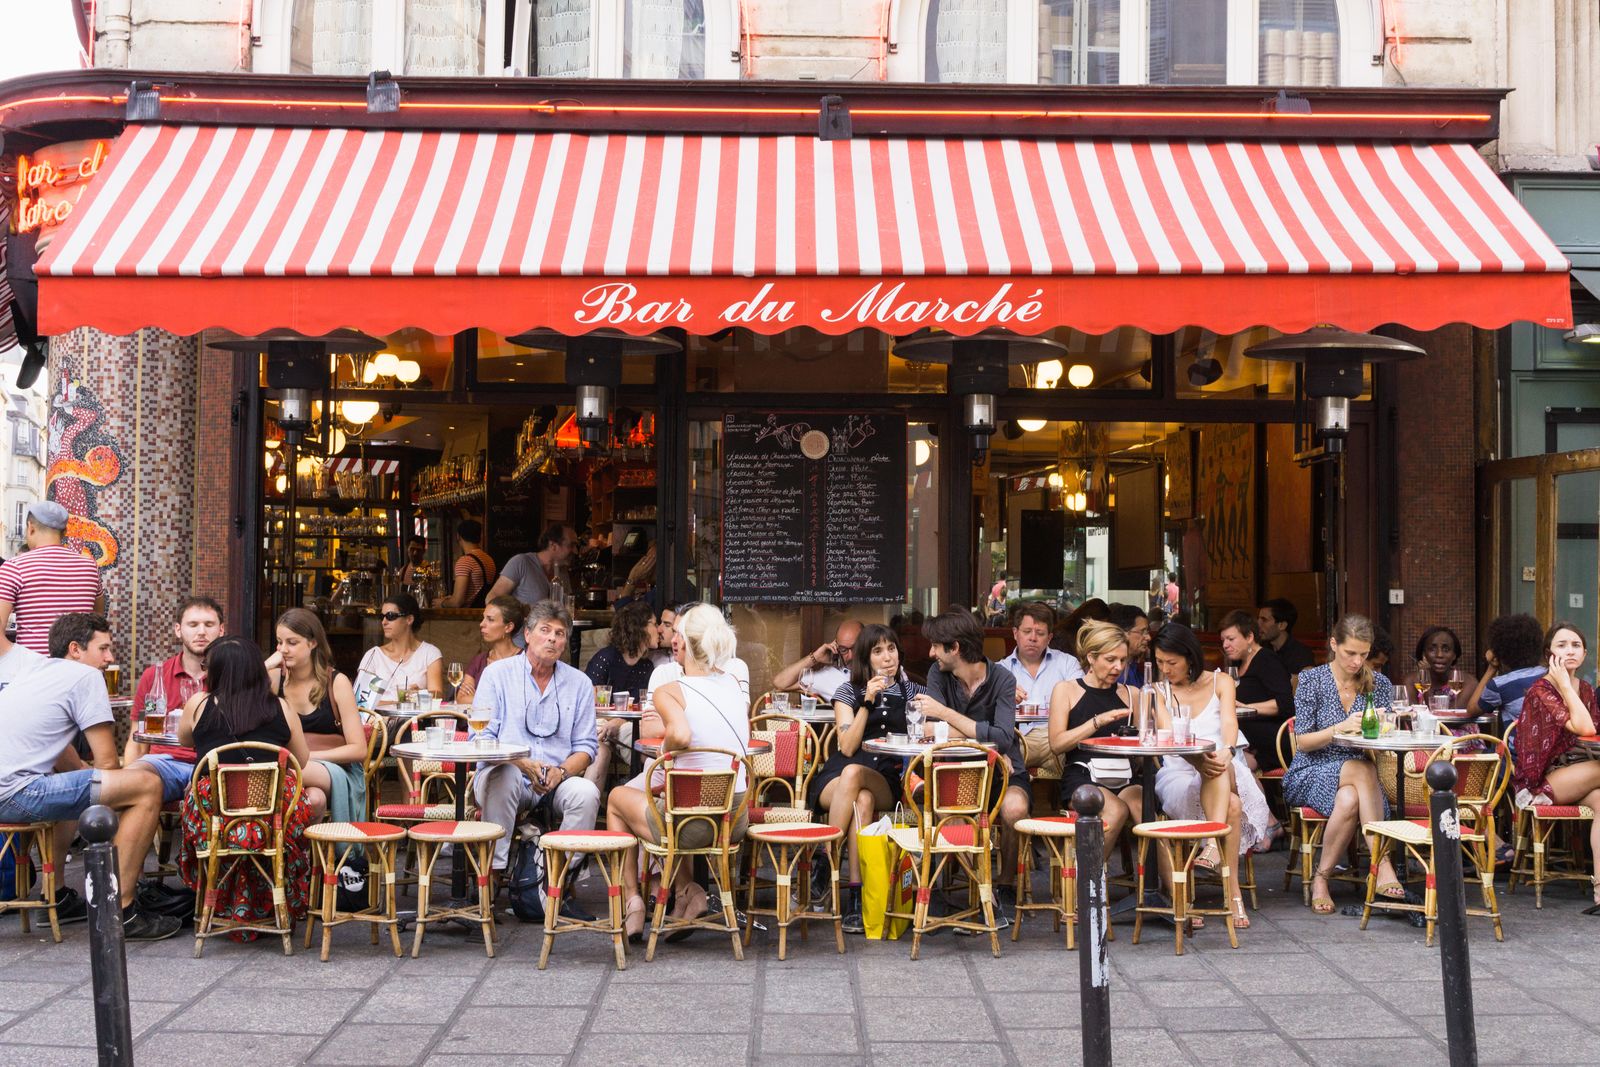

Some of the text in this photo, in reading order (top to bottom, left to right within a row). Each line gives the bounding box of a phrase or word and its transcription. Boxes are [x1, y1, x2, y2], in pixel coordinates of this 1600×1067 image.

[79, 142, 107, 177] d
[574, 282, 1043, 324] Bar du Marché
